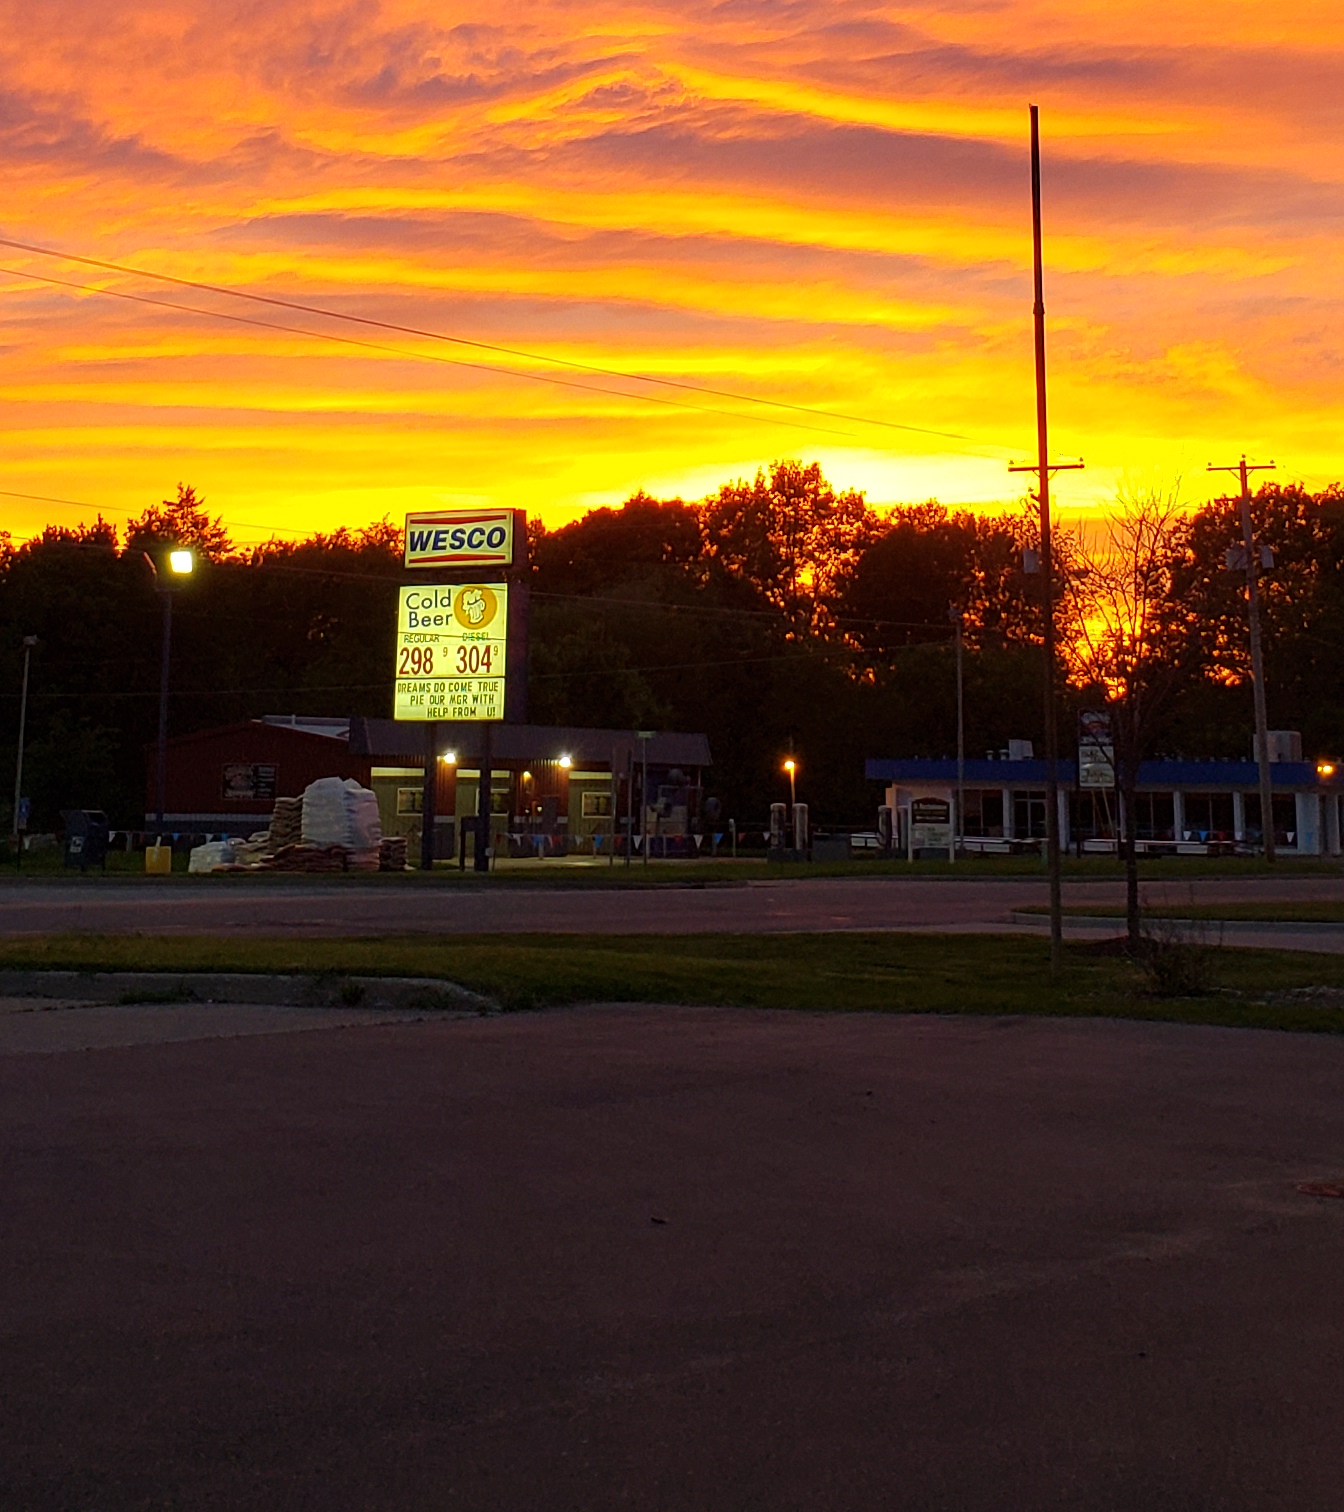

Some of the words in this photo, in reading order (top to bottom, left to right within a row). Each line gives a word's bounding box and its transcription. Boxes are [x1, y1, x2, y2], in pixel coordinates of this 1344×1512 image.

[409, 526, 506, 552] WESCO
[406, 589, 451, 610] Cold
[409, 611, 453, 628] Beer
[403, 633, 440, 643] REGULAR
[462, 632, 489, 642] DIESEL
[399, 646, 433, 675] 298
[456, 645, 492, 673] 304
[397, 682, 431, 693] DREAMS
[434, 682, 445, 693] DO
[448, 681, 472, 692] COME
[478, 681, 498, 692] TRUE
[410, 694, 424, 705] PIE
[430, 694, 445, 705] OUR
[449, 694, 468, 704] MGR
[472, 694, 494, 704] WITH
[427, 707, 448, 718] HELP
[453, 706, 476, 717] FROM
